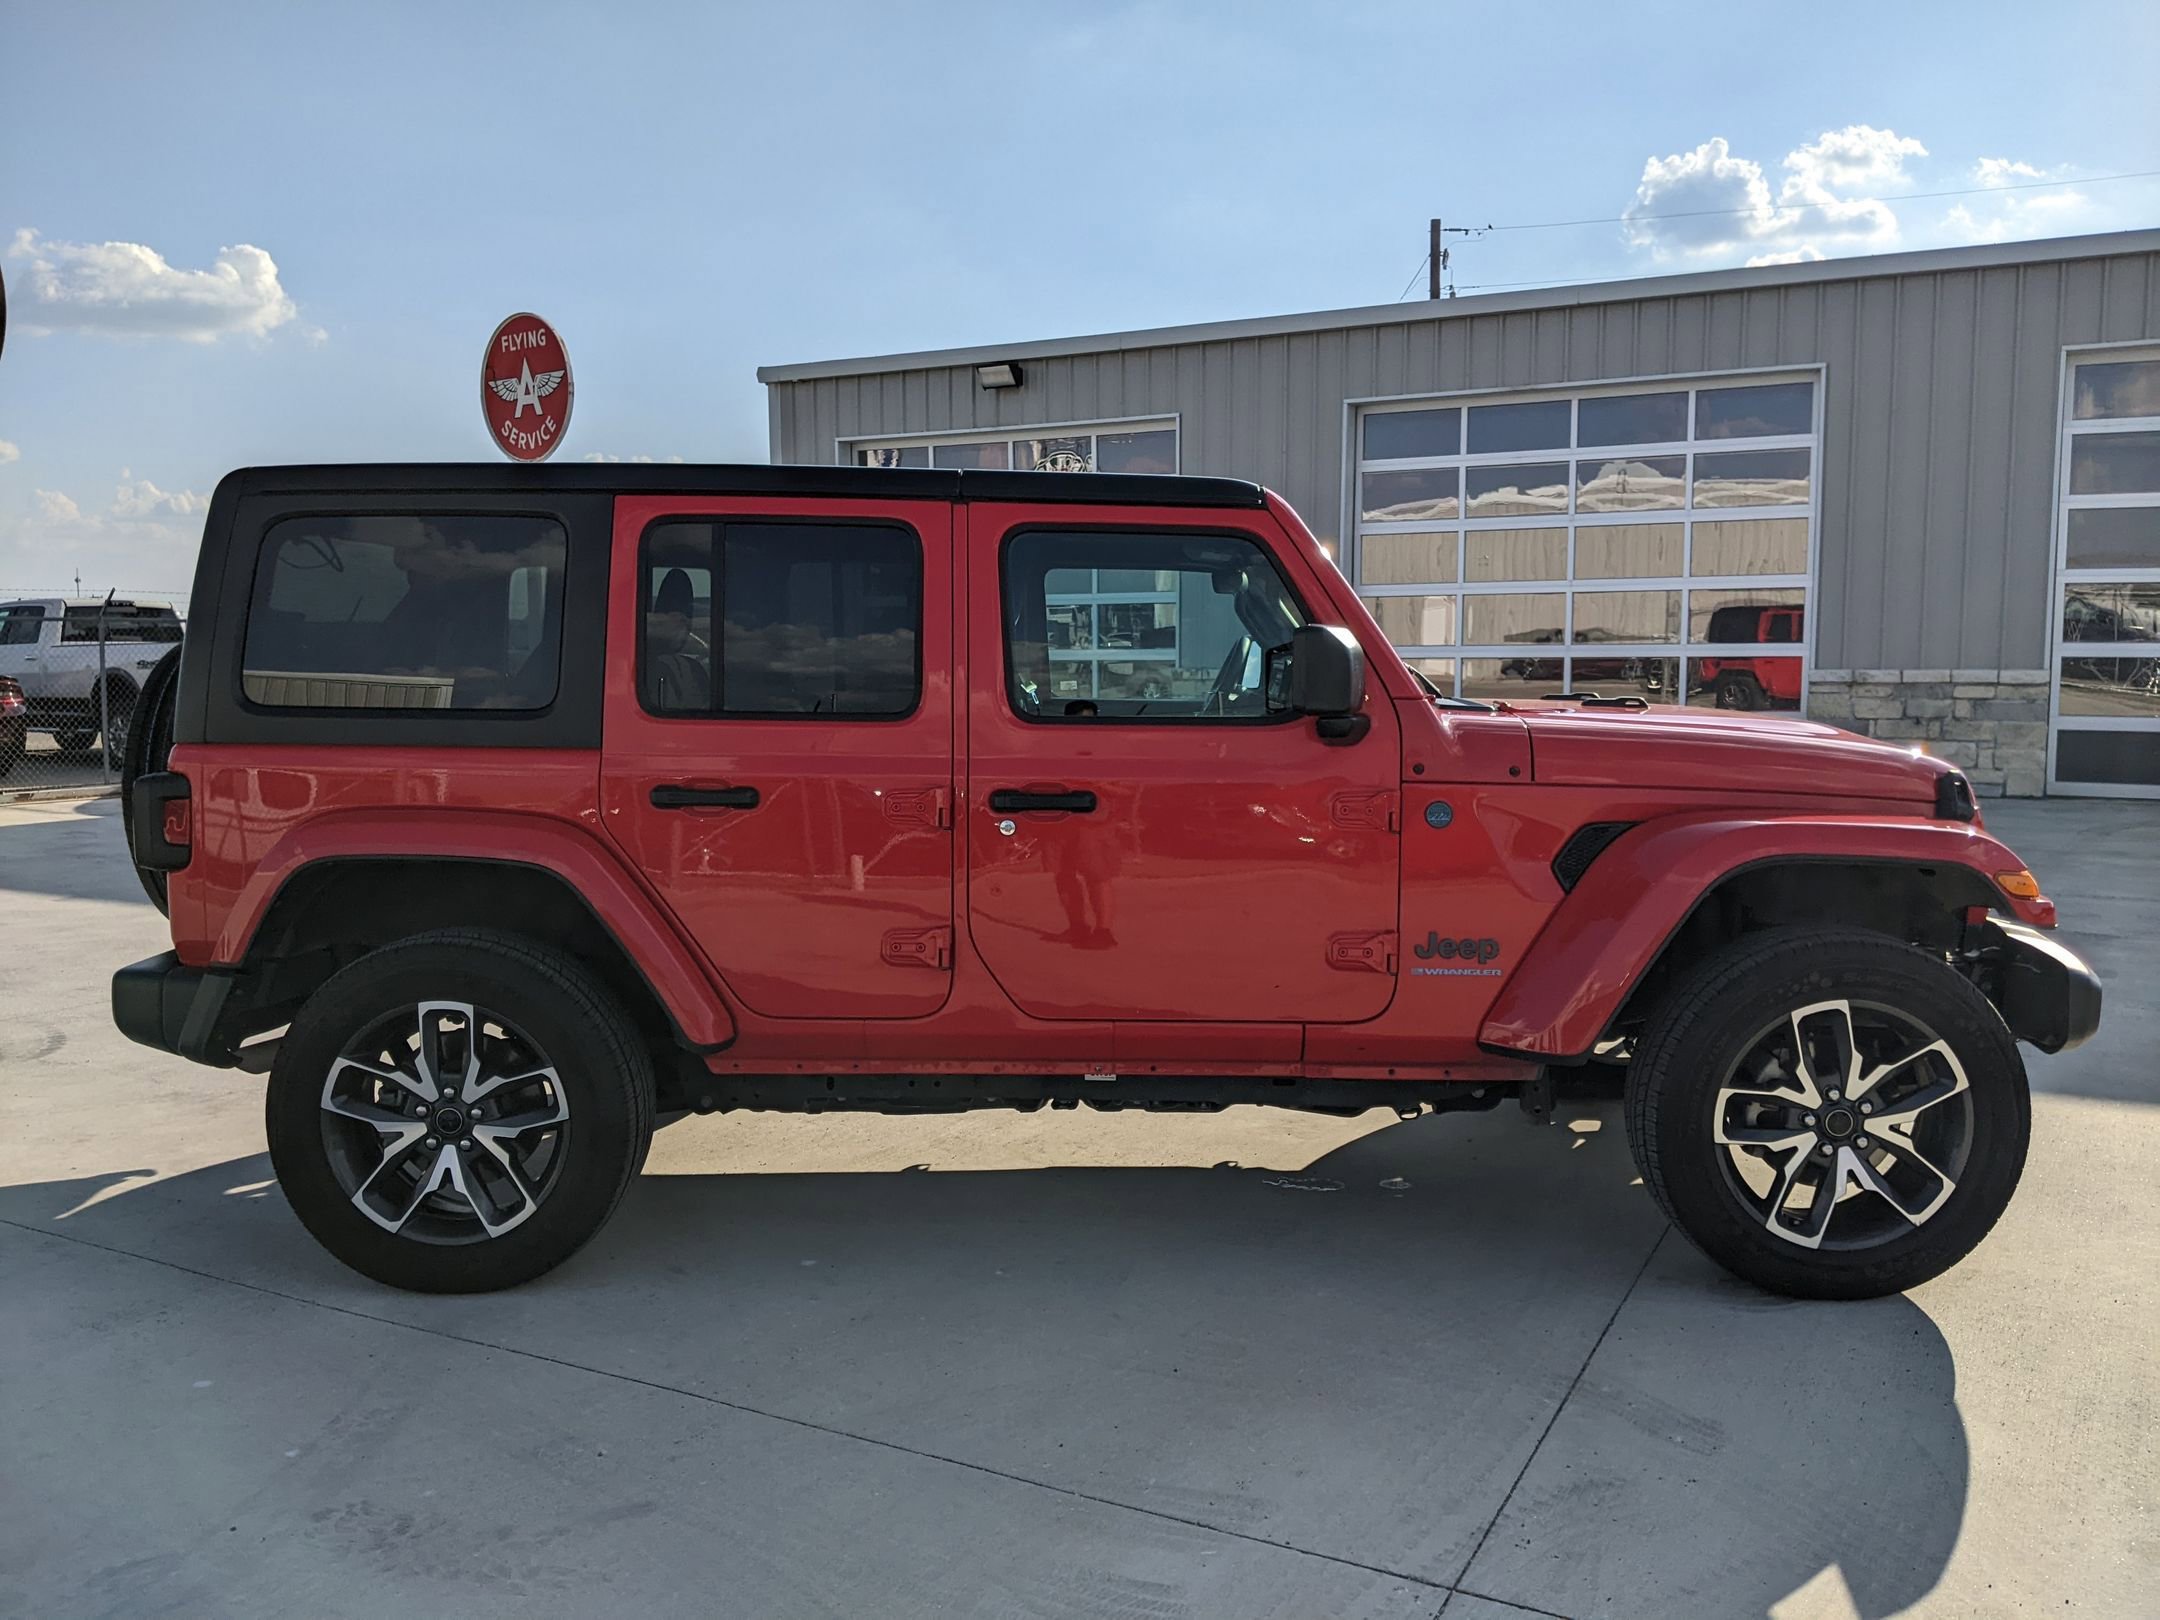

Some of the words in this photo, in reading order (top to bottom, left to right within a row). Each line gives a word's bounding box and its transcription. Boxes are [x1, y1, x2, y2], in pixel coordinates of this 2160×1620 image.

[502, 328, 546, 352] FLYING
[514, 356, 544, 419] A
[502, 416, 556, 449] SERVICE
[1414, 931, 1499, 964] Jeep
[1424, 967, 1502, 977] WRANGLER
